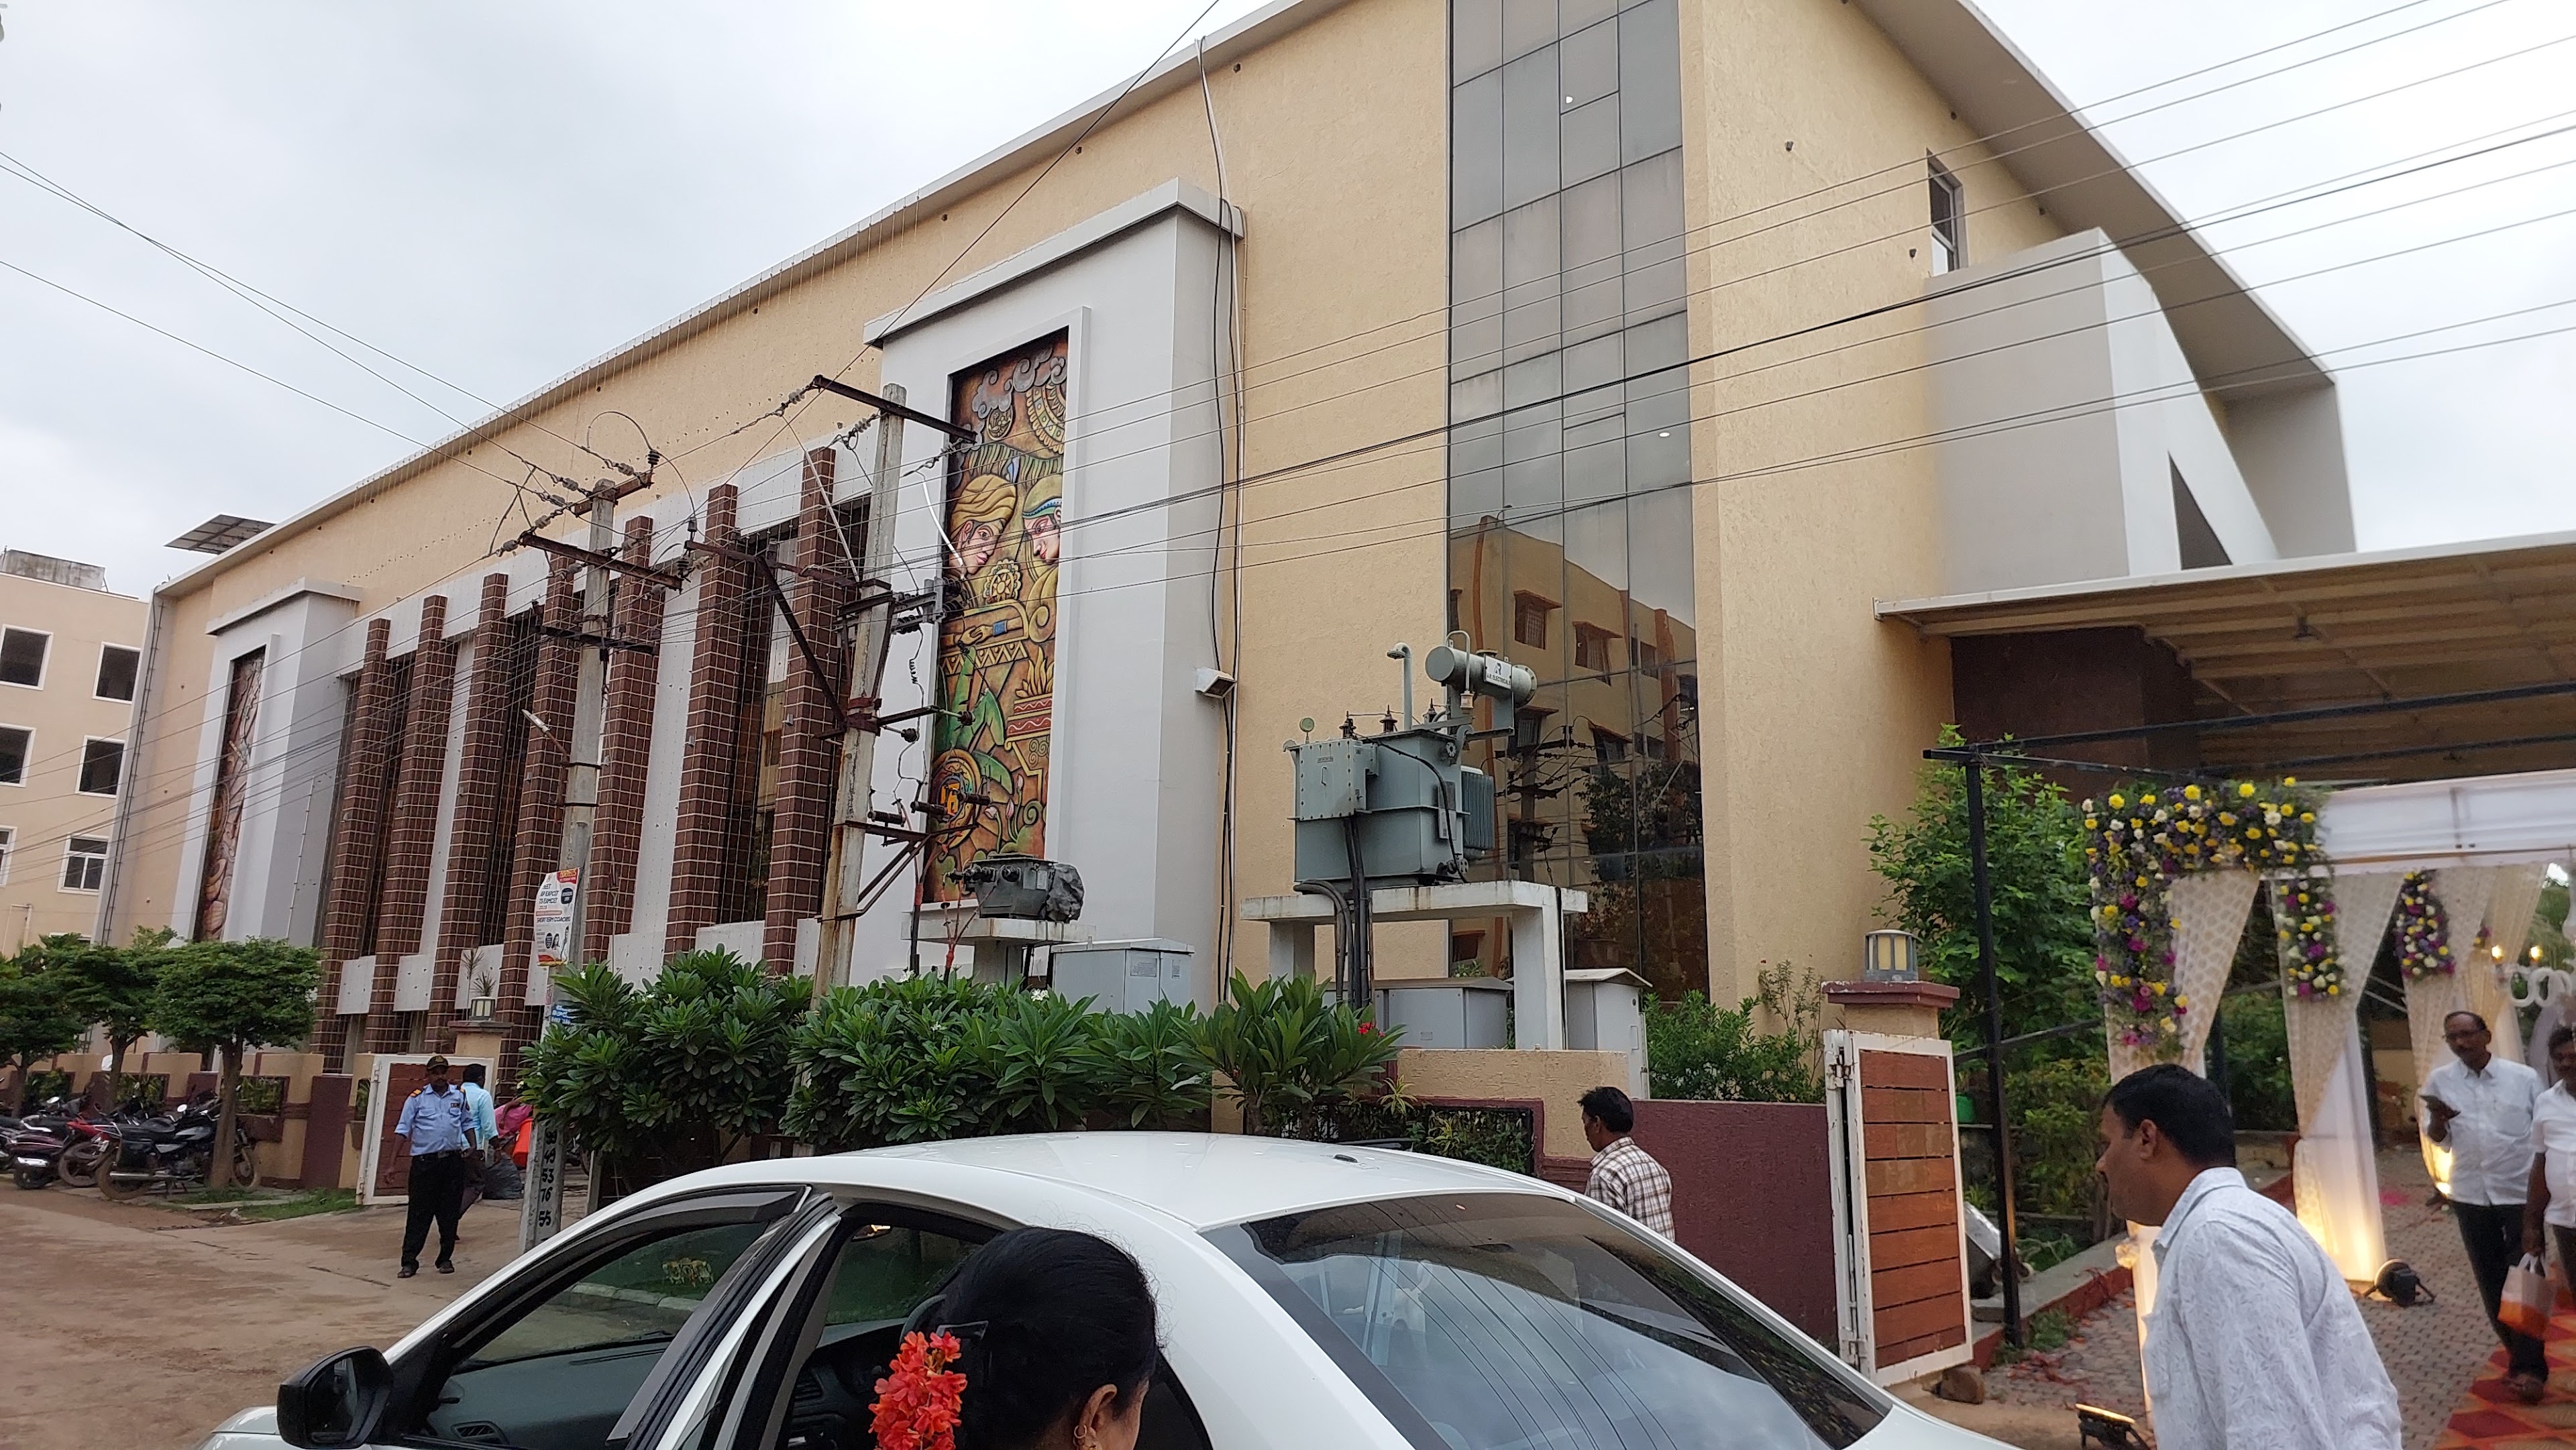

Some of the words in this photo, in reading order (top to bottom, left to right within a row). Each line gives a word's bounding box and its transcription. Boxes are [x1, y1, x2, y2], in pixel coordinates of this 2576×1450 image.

[543, 1147, 556, 1164] 49
[541, 1168, 555, 1184] 53
[541, 1186, 553, 1203] 76
[539, 1209, 551, 1227] 55
